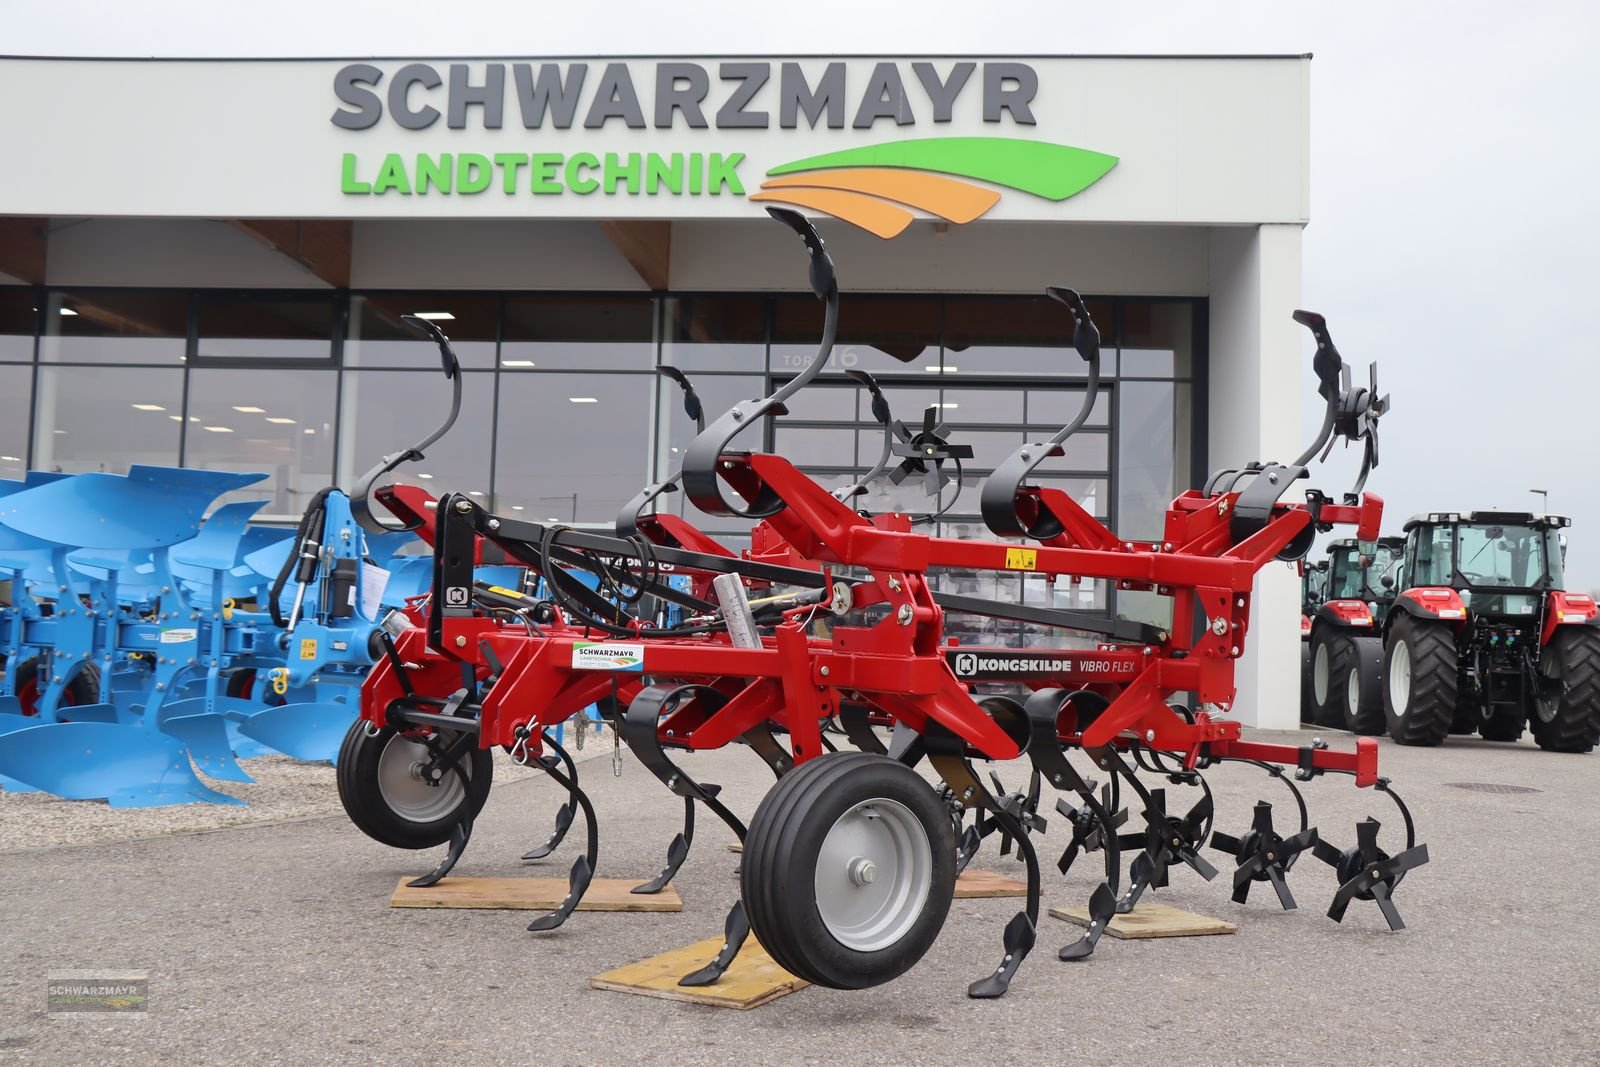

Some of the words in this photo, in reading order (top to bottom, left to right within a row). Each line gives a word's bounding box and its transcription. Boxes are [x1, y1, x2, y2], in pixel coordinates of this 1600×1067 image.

[331, 61, 1038, 130] SCHWARZMAYR
[341, 152, 746, 195] LANDTECHNIK
[783, 355, 813, 366] TOR
[831, 346, 858, 367] 16
[579, 648, 634, 657] SCHWARZMAYR
[978, 659, 1072, 672] KONGSKILDE
[1079, 660, 1111, 673] VIBRO
[1111, 661, 1135, 673] FLEX
